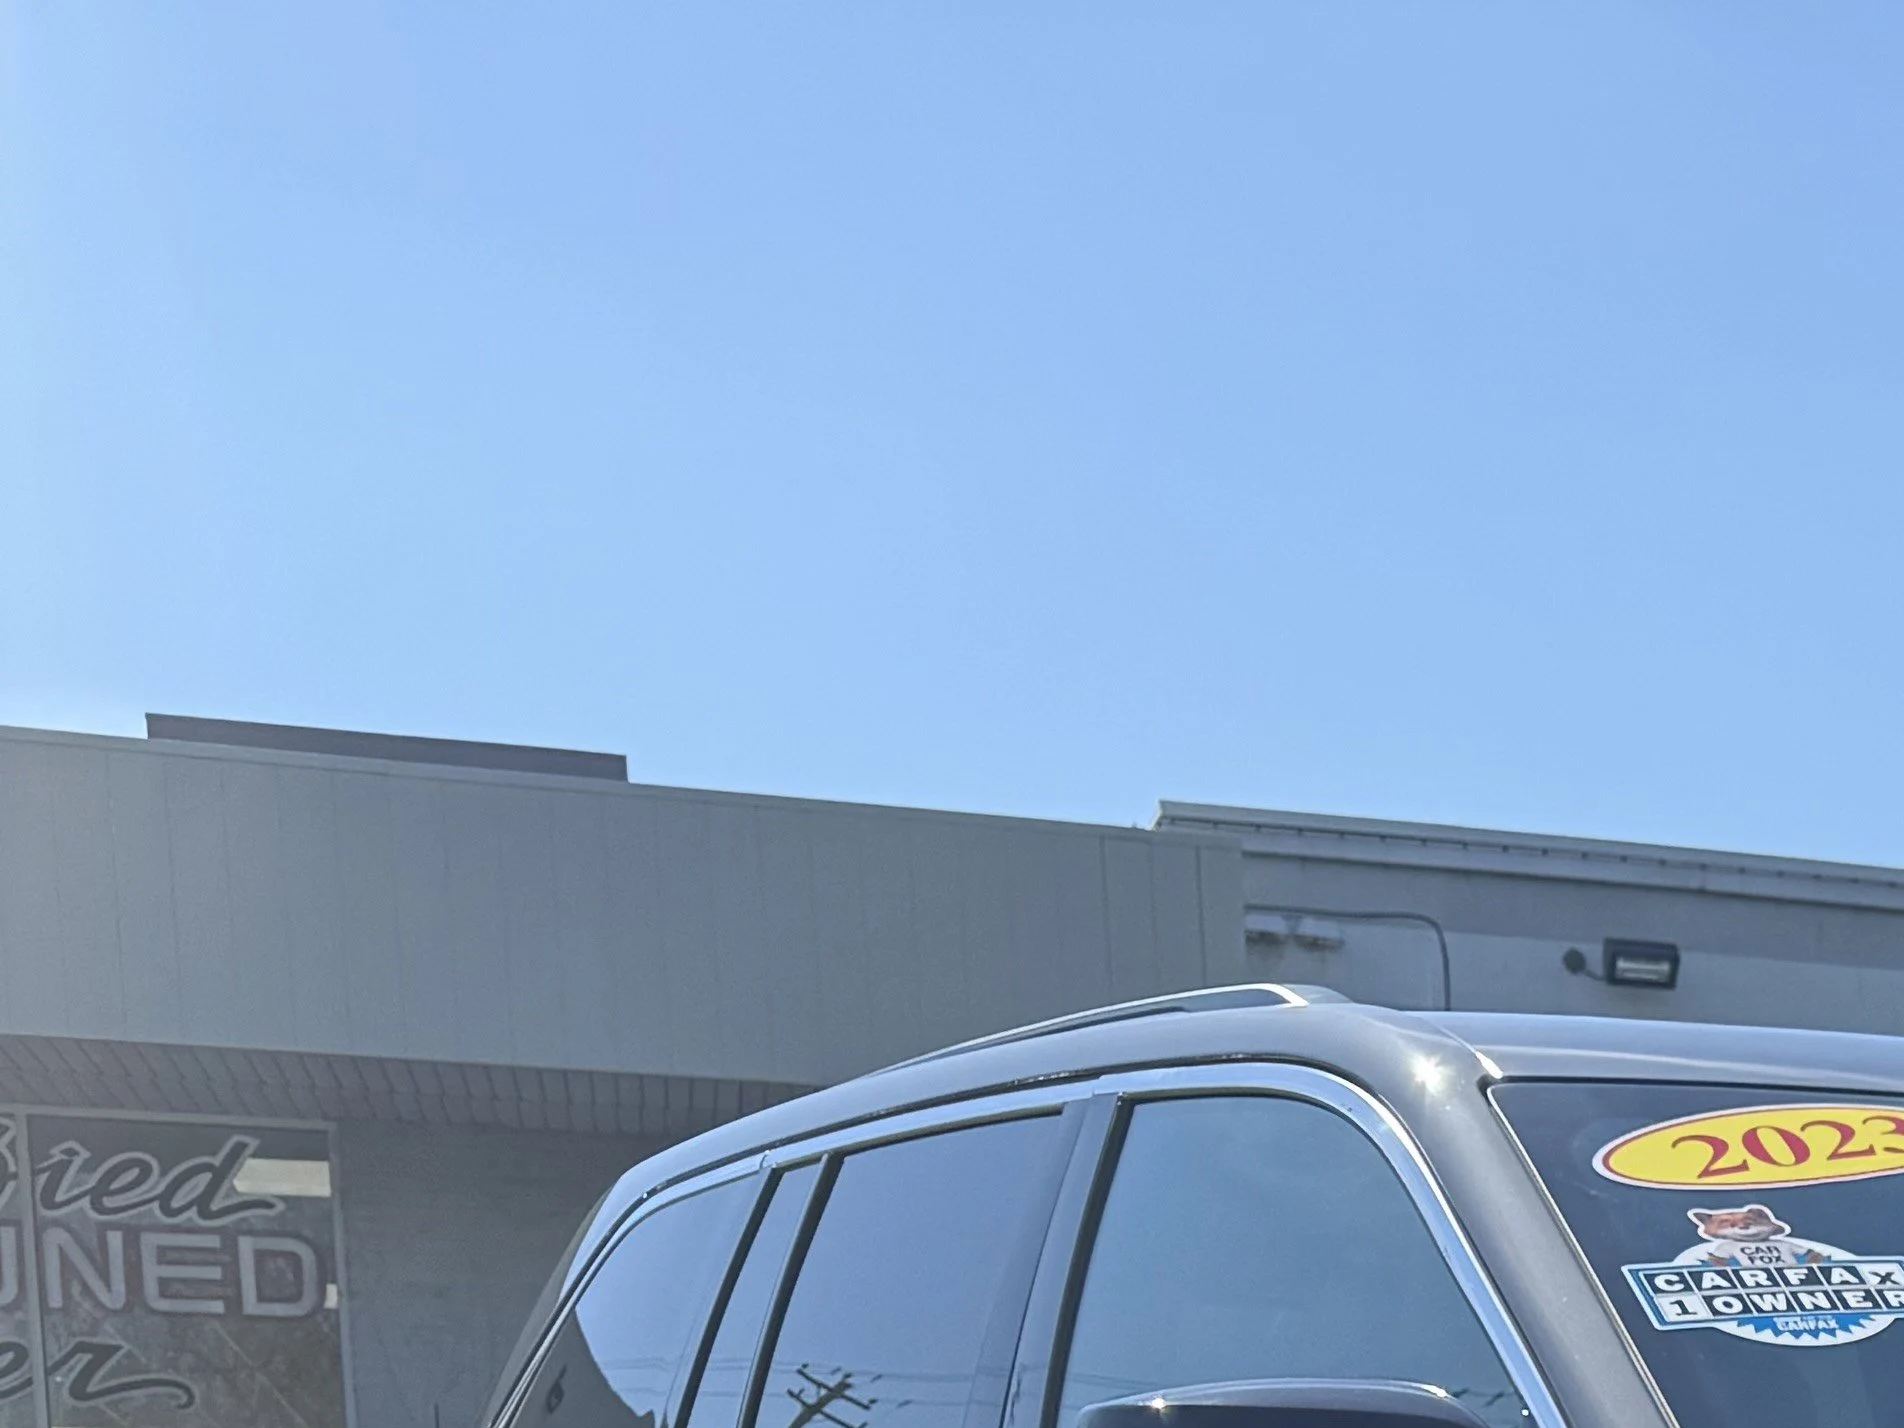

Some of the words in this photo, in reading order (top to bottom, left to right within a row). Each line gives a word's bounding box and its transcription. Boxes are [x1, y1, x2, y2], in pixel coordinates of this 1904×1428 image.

[1747, 1255, 1786, 1266] FOX
[1653, 1266, 1901, 1293] CARFAX
[1668, 1299, 1698, 1317] 1
